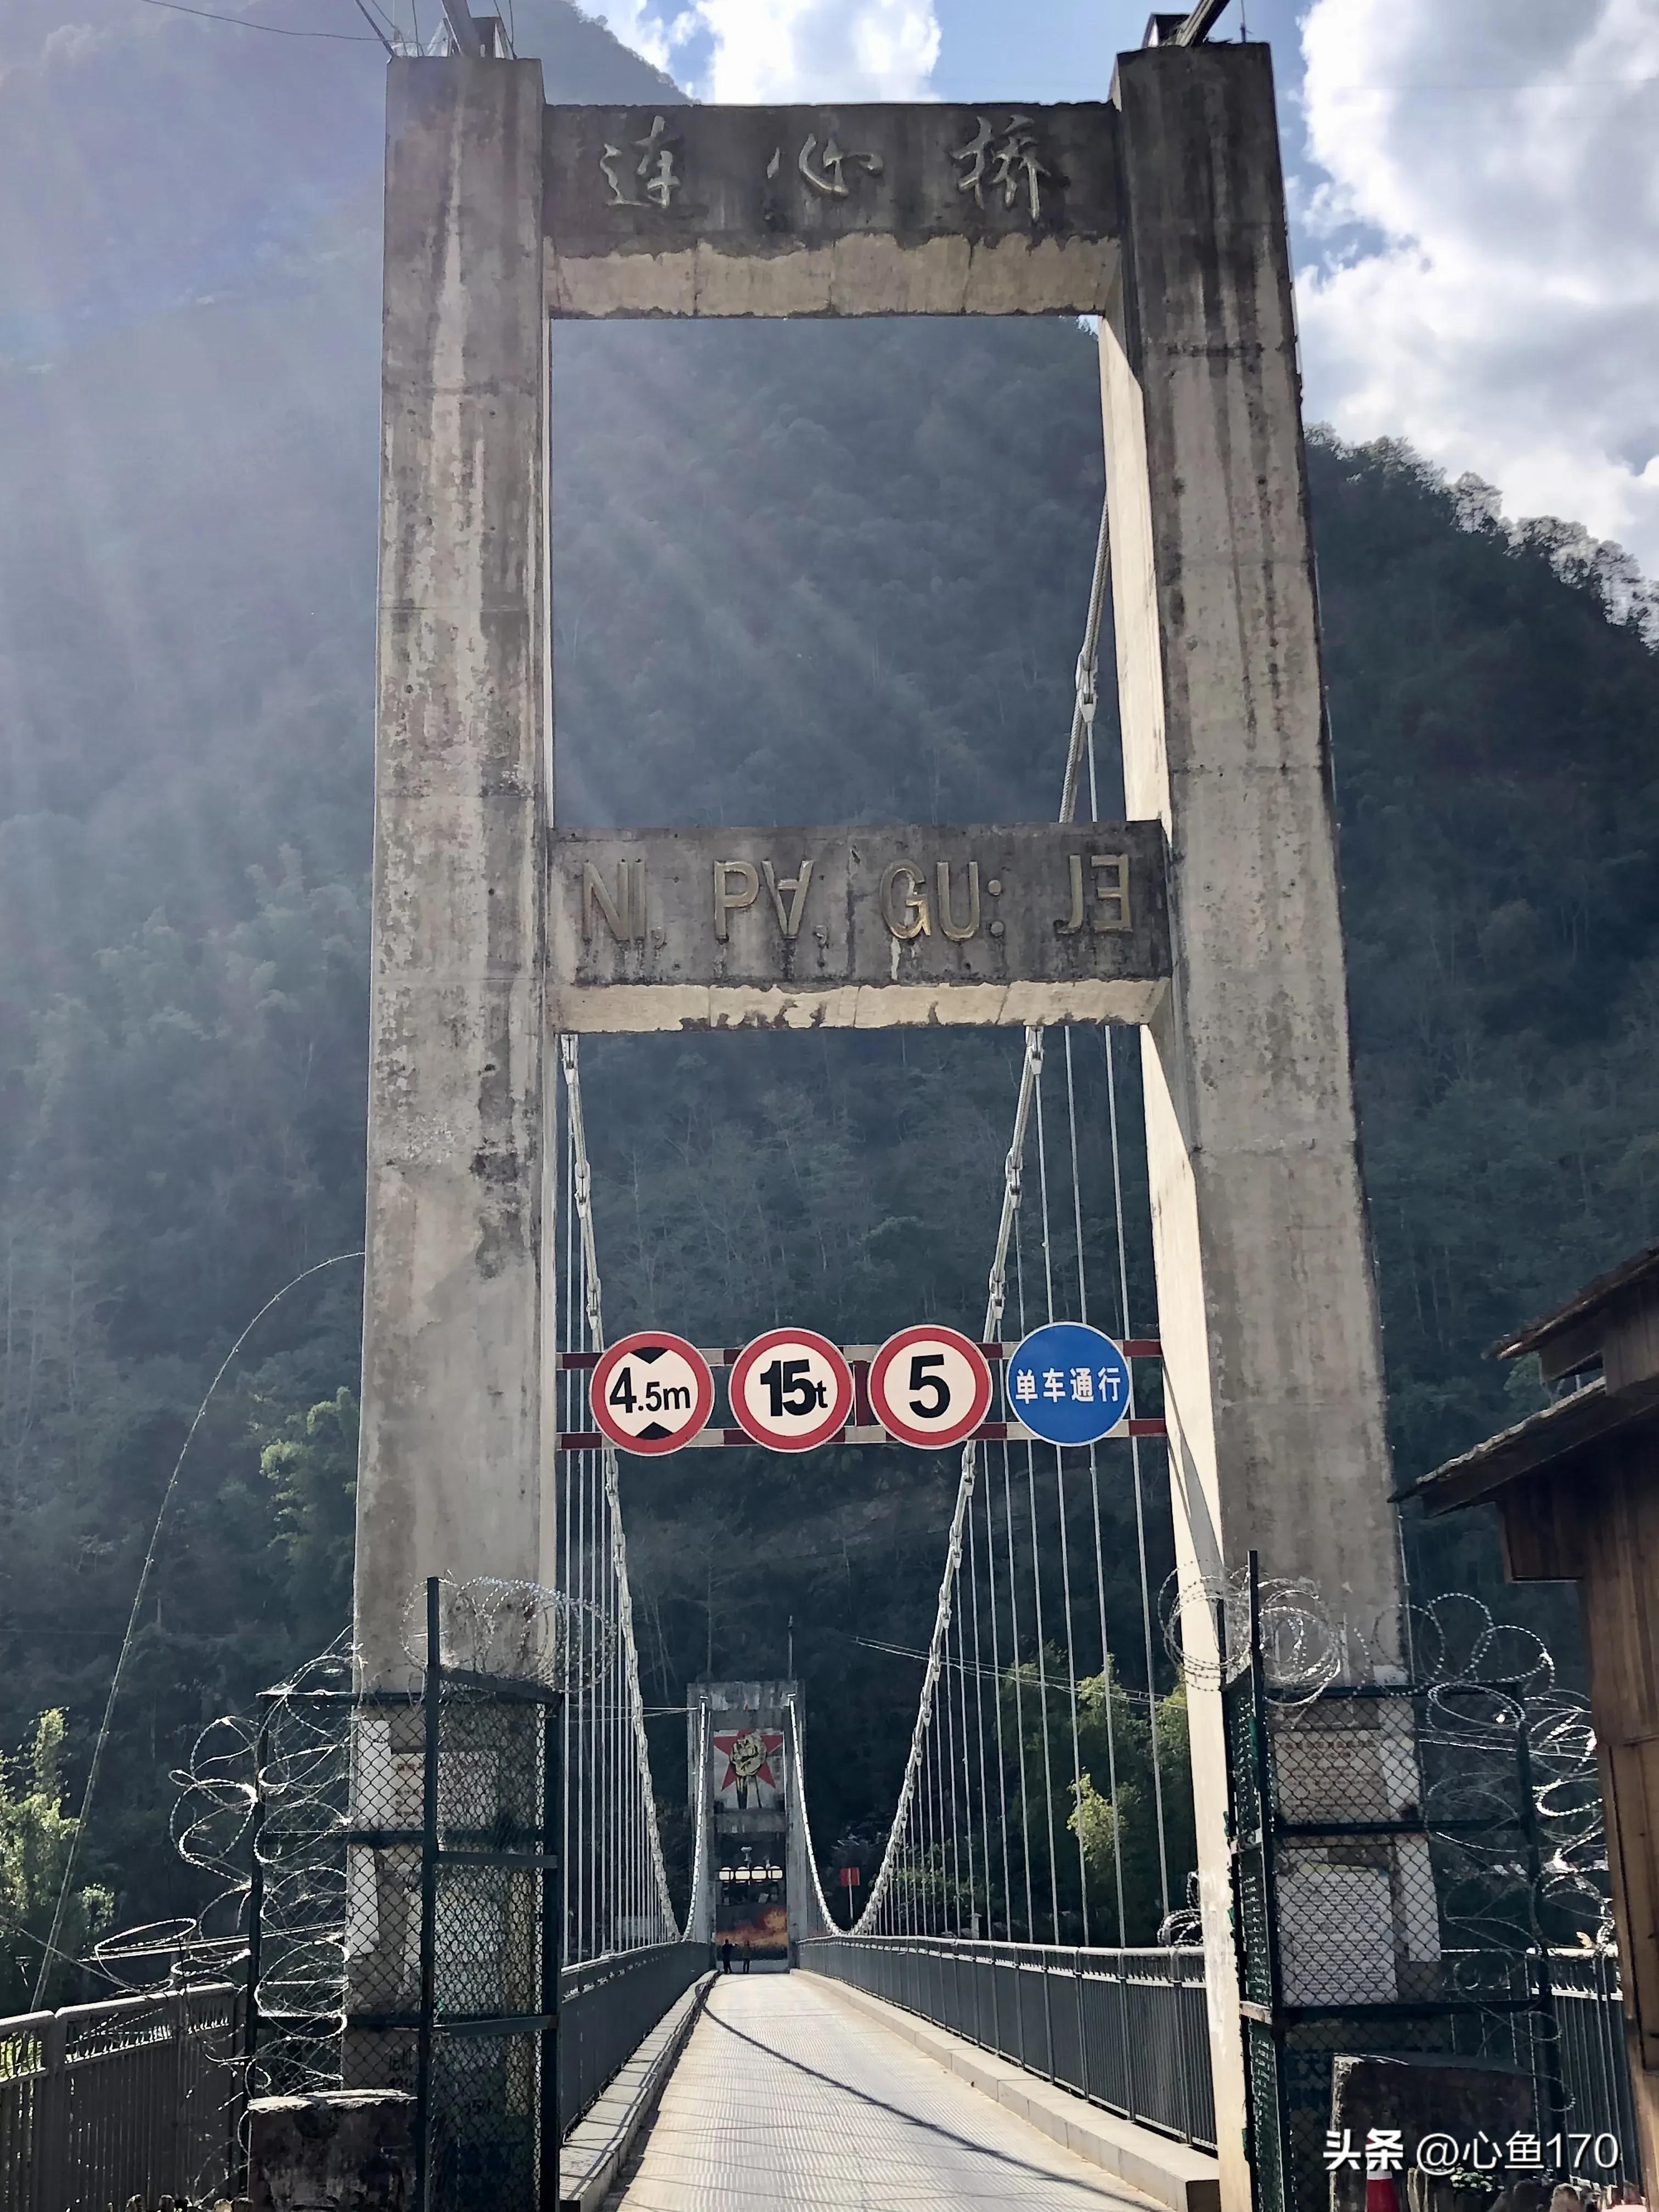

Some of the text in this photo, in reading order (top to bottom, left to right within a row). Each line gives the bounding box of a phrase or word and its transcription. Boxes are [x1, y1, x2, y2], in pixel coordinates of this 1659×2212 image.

[610, 1367, 691, 1414] 4.5m
[760, 1359, 828, 1417] 15t
[909, 1354, 951, 1419] 5
[1015, 1367, 1121, 1404] 单车通行
